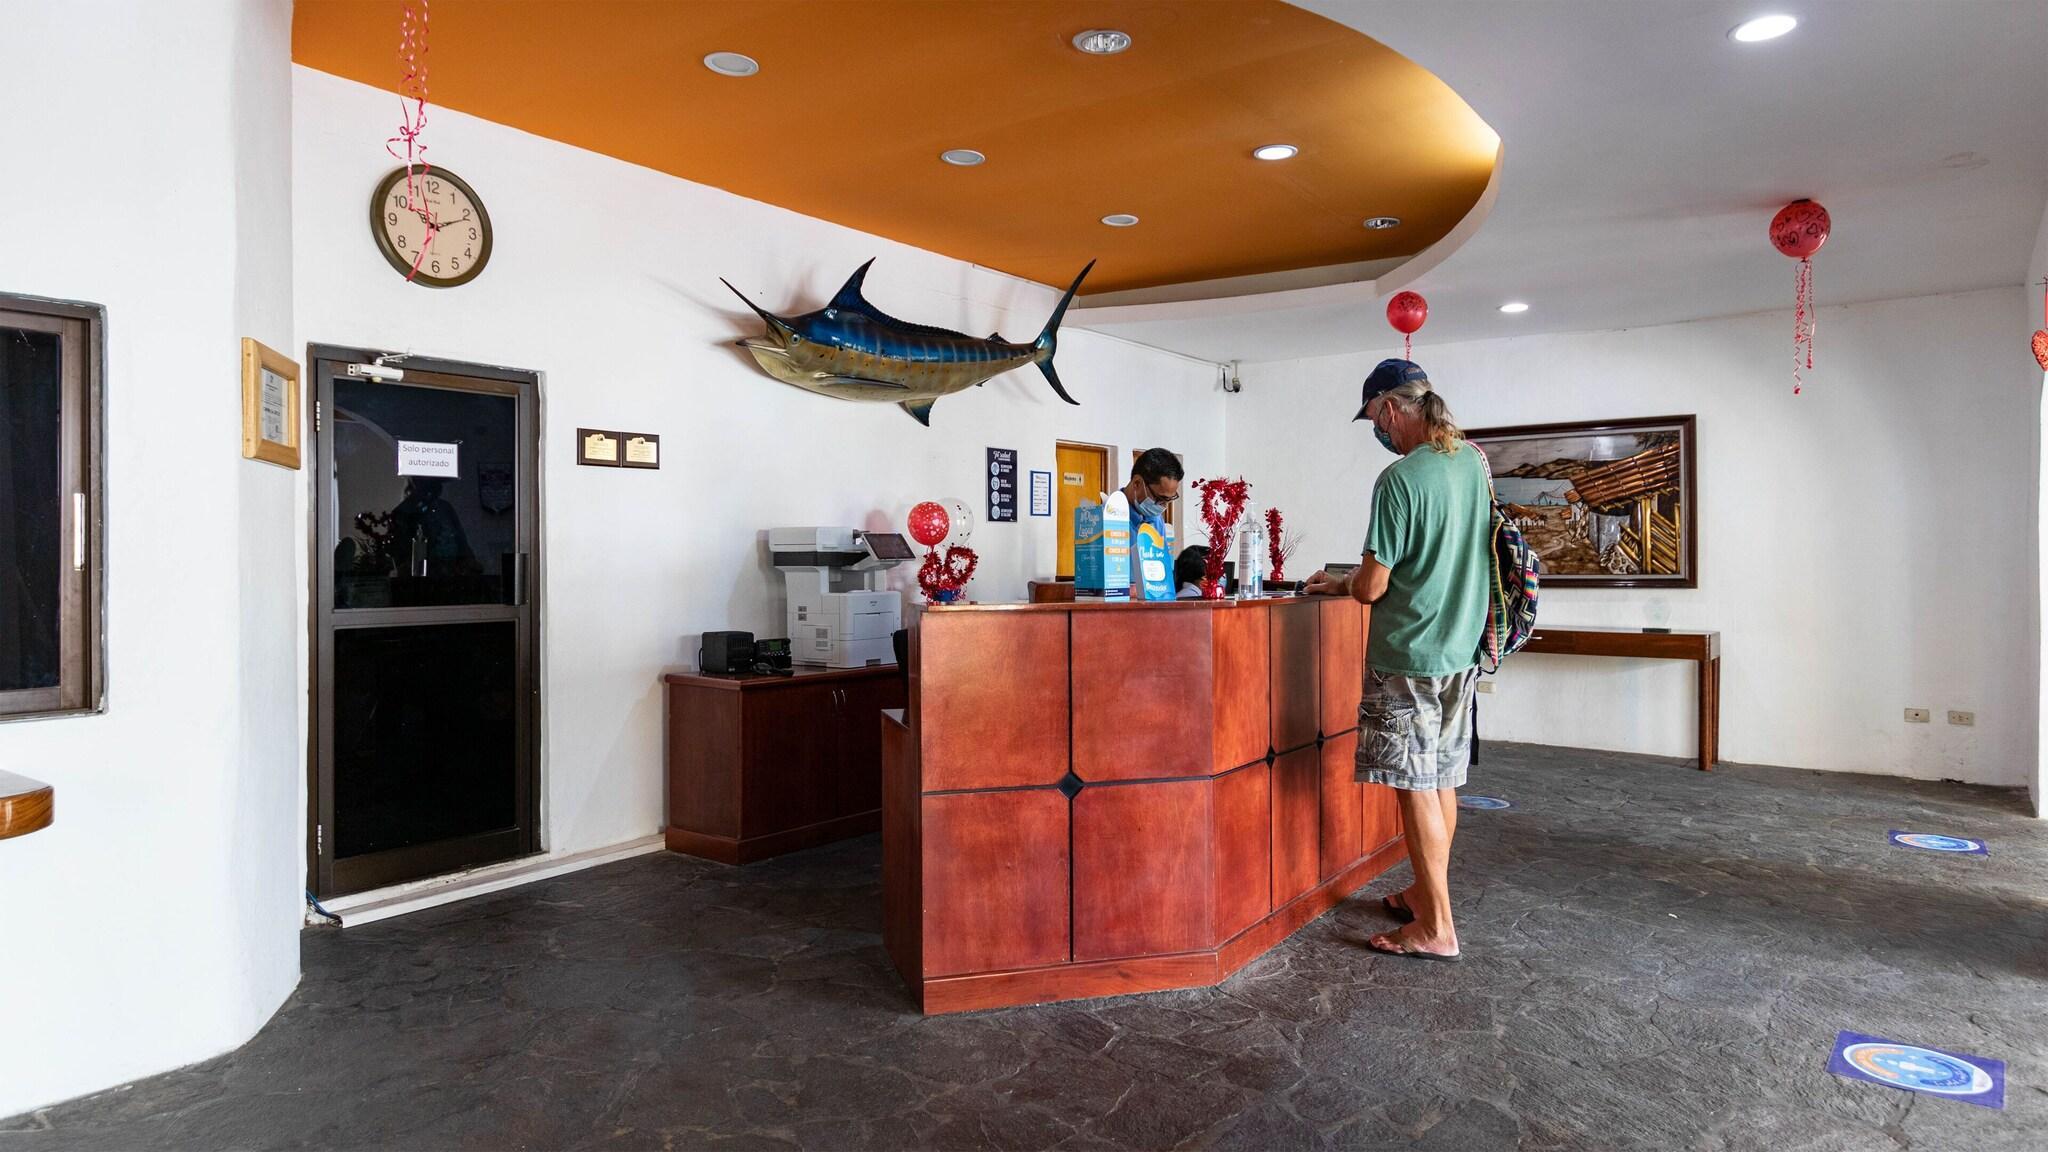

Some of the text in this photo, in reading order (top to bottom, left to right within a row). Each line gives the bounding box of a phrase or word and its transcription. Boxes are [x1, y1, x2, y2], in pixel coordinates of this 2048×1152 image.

[426, 181, 440, 195] 12
[393, 195, 408, 209] 10
[450, 193, 456, 204] 1
[388, 212, 398, 226] 9
[462, 208, 471, 221] 2
[468, 227, 477, 241] 3
[397, 235, 406, 249] 8
[411, 250, 420, 263] 7
[464, 247, 472, 259] 4
[431, 260, 440, 274] 6
[451, 257, 460, 270] 5
[402, 444, 455, 455] Solo personal
[408, 459, 450, 468] autorizado
